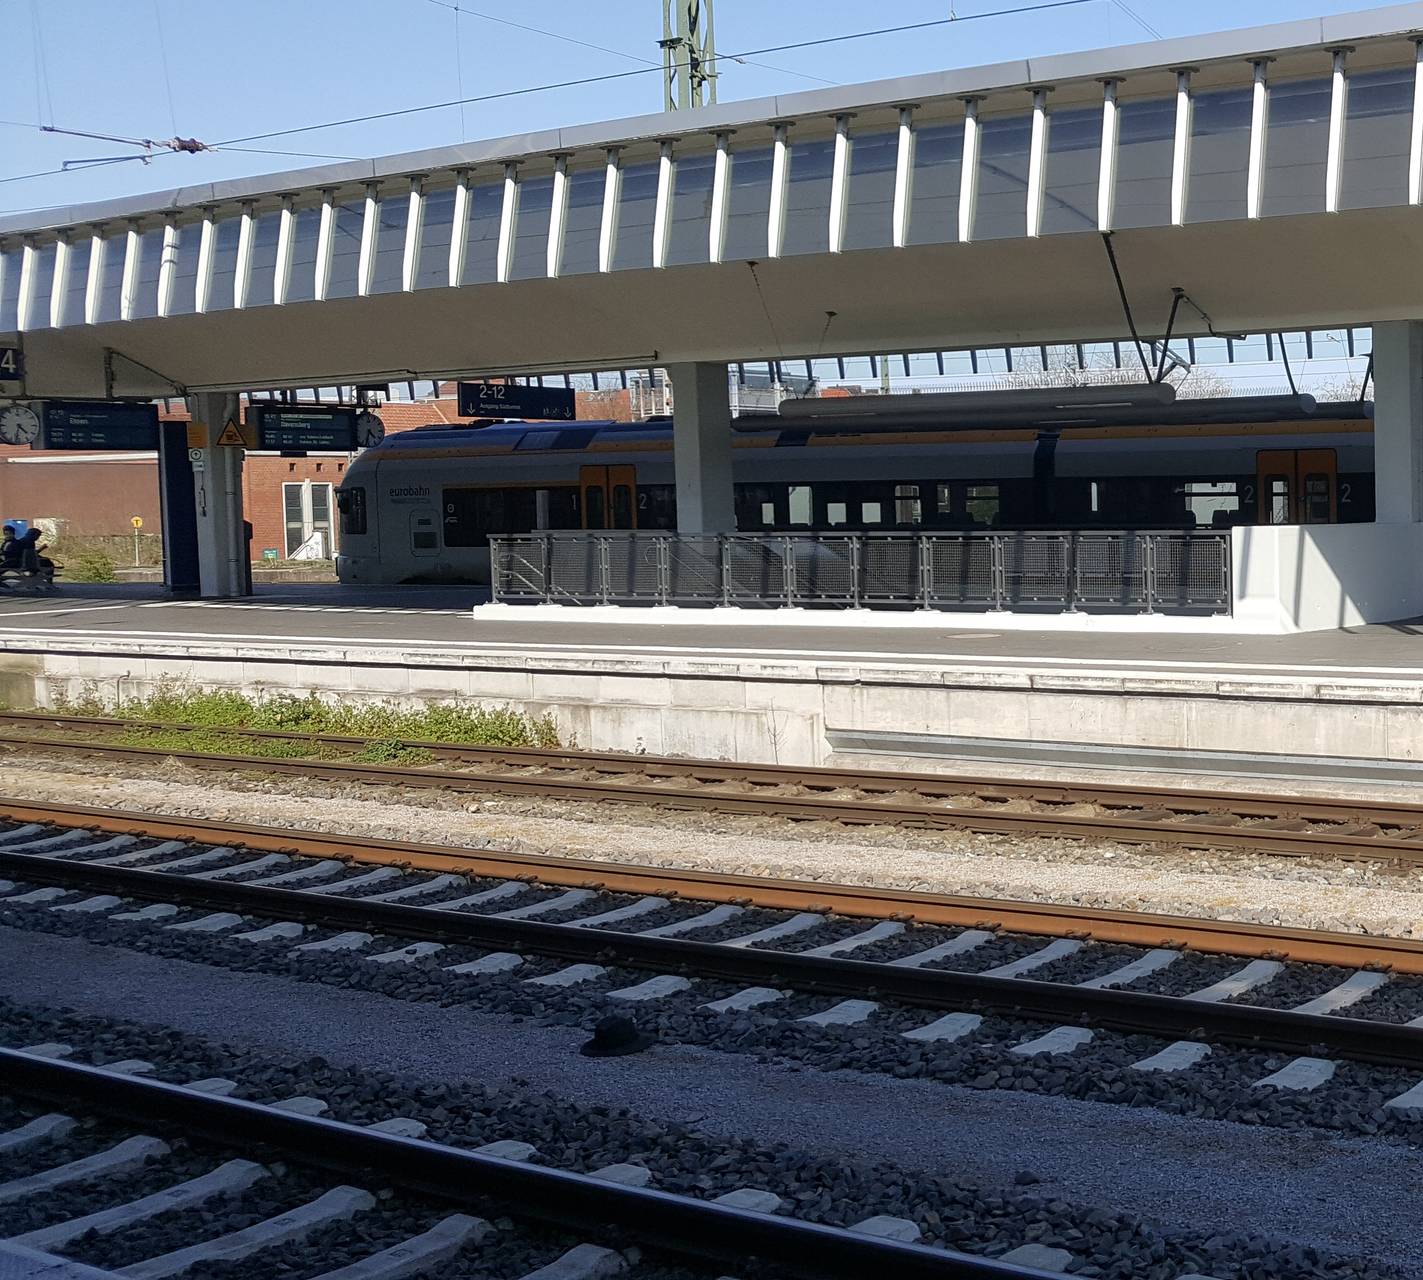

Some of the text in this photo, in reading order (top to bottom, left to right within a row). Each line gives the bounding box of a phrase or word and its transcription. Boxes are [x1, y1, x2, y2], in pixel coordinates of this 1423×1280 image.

[0, 350, 16, 373] 4
[480, 385, 504, 398] 2-12
[390, 486, 430, 496] eurobahn
[1243, 484, 1254, 504] 2
[1341, 484, 1352, 502] 2
[640, 494, 648, 510] 2
